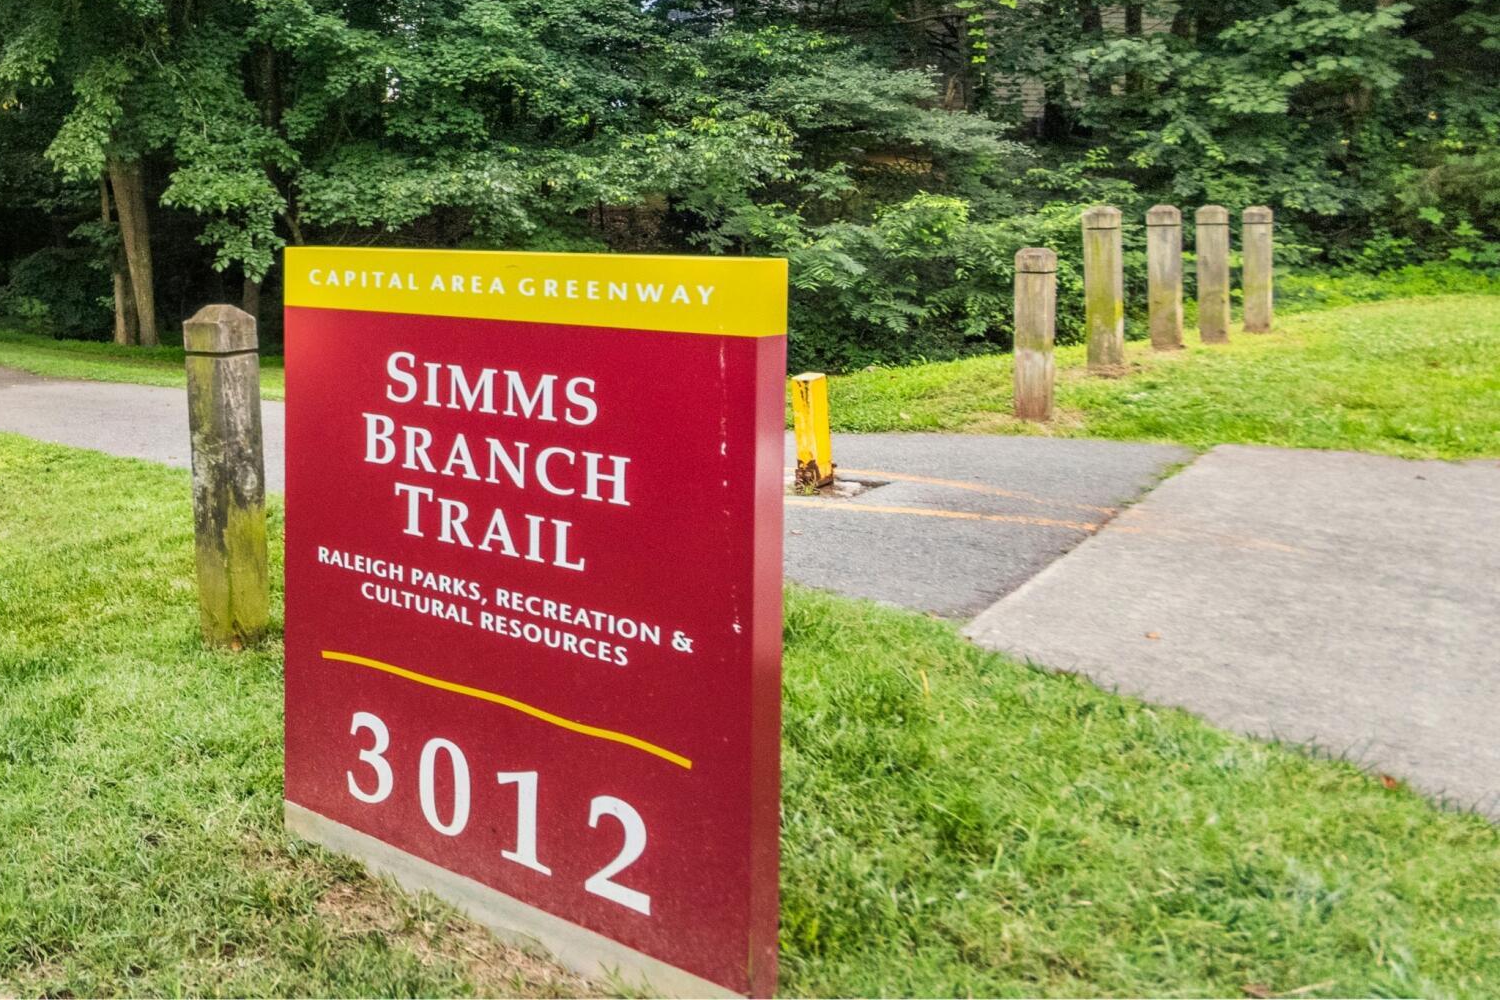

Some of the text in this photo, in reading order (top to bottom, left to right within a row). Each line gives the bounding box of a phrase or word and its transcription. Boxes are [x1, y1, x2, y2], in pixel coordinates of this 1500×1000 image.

[309, 269, 715, 305] CAPITAL AREA GREENWAY
[385, 351, 598, 426] SIMMS
[362, 412, 631, 507] BRANCH
[394, 482, 586, 572] TRAIL
[318, 546, 694, 654] RALEIGH PARKS, RECREATION &
[361, 581, 629, 667] CULTURAL RESOURCES
[346, 711, 651, 916] 3012
